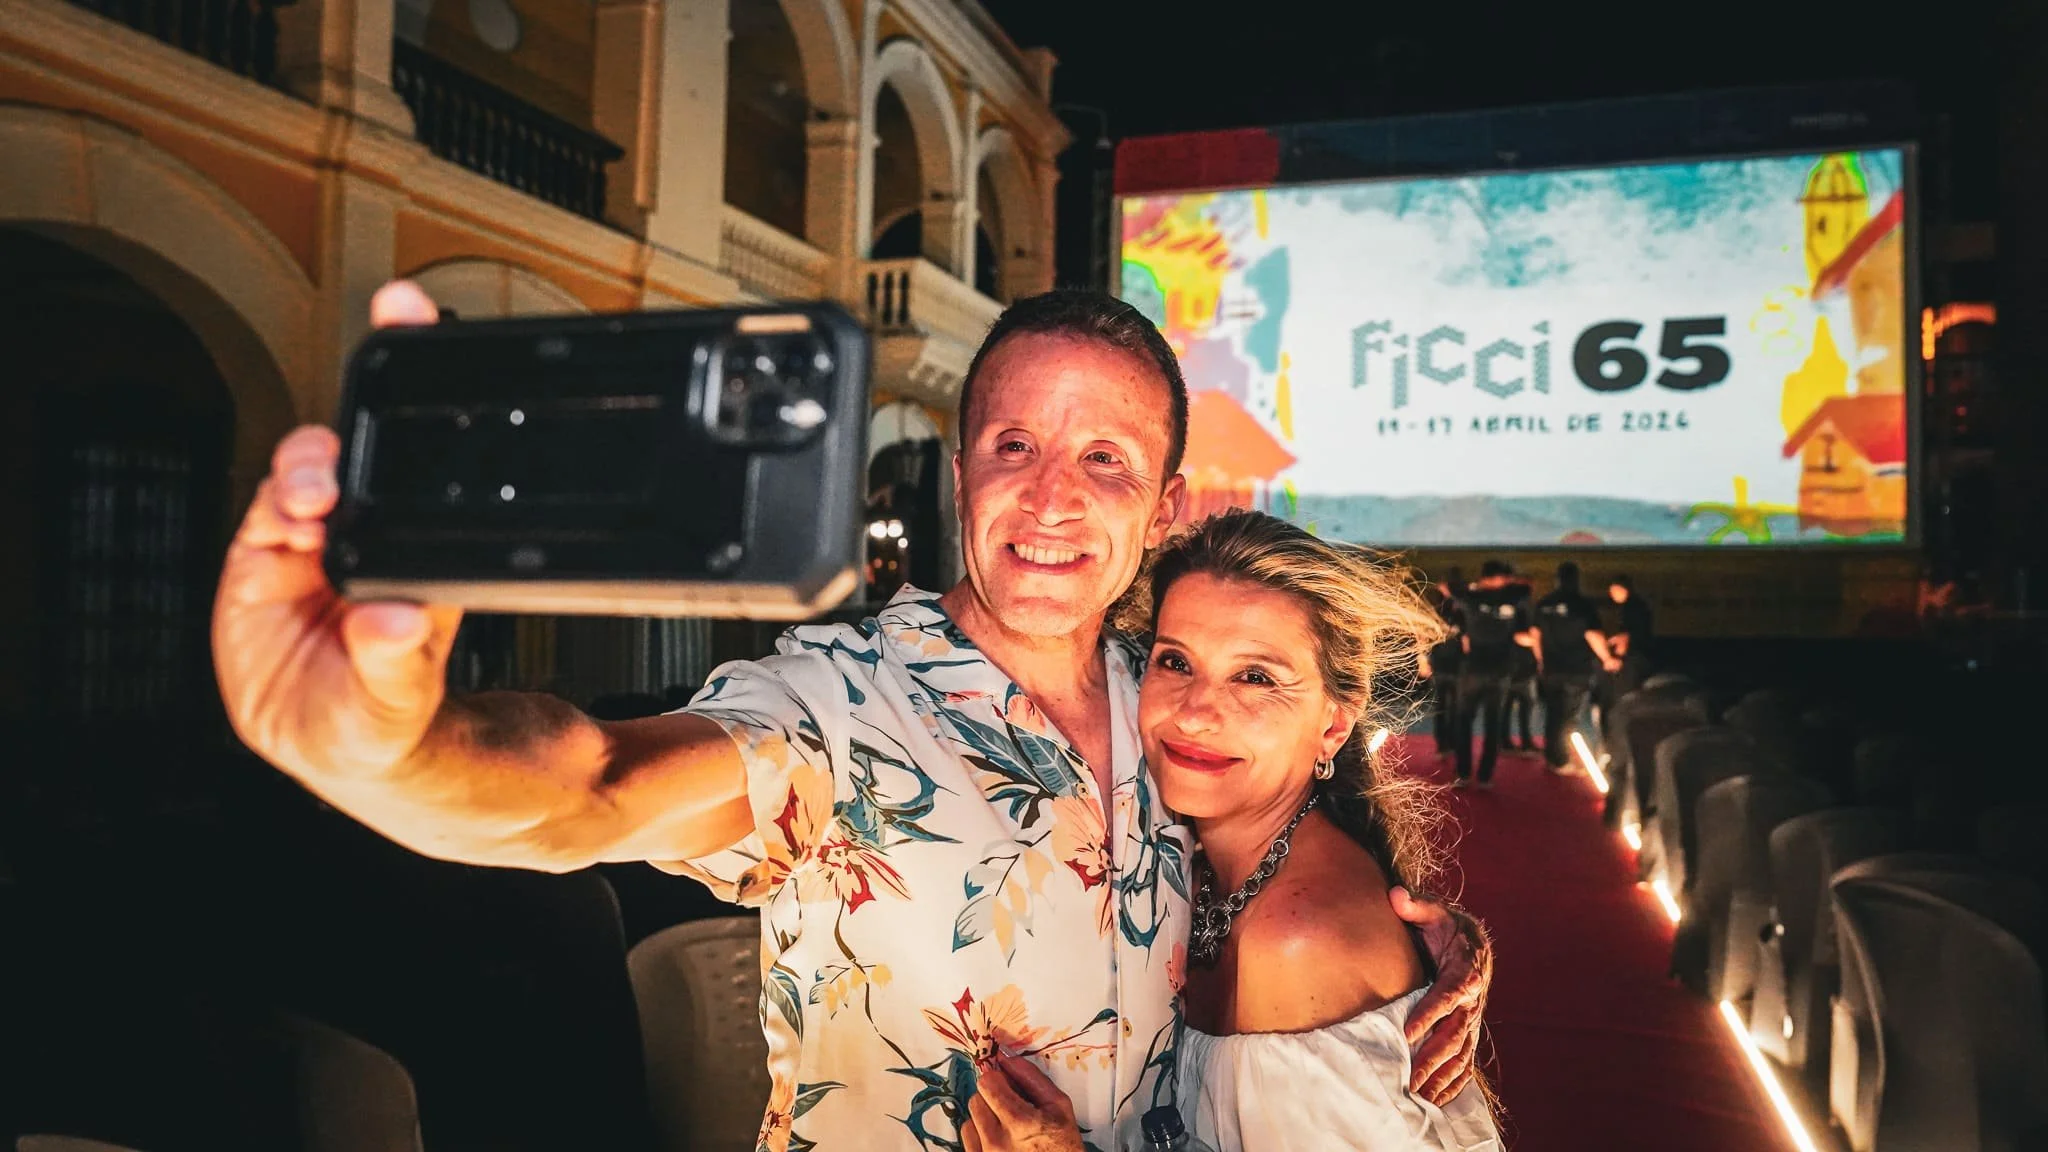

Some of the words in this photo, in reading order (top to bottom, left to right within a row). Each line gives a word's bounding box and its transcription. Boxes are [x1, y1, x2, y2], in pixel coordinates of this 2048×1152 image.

[1571, 315, 1732, 394] 65
[1469, 415, 1551, 434] ABRIL
[1566, 413, 1601, 434] DE
[1620, 409, 1691, 432] 2026
